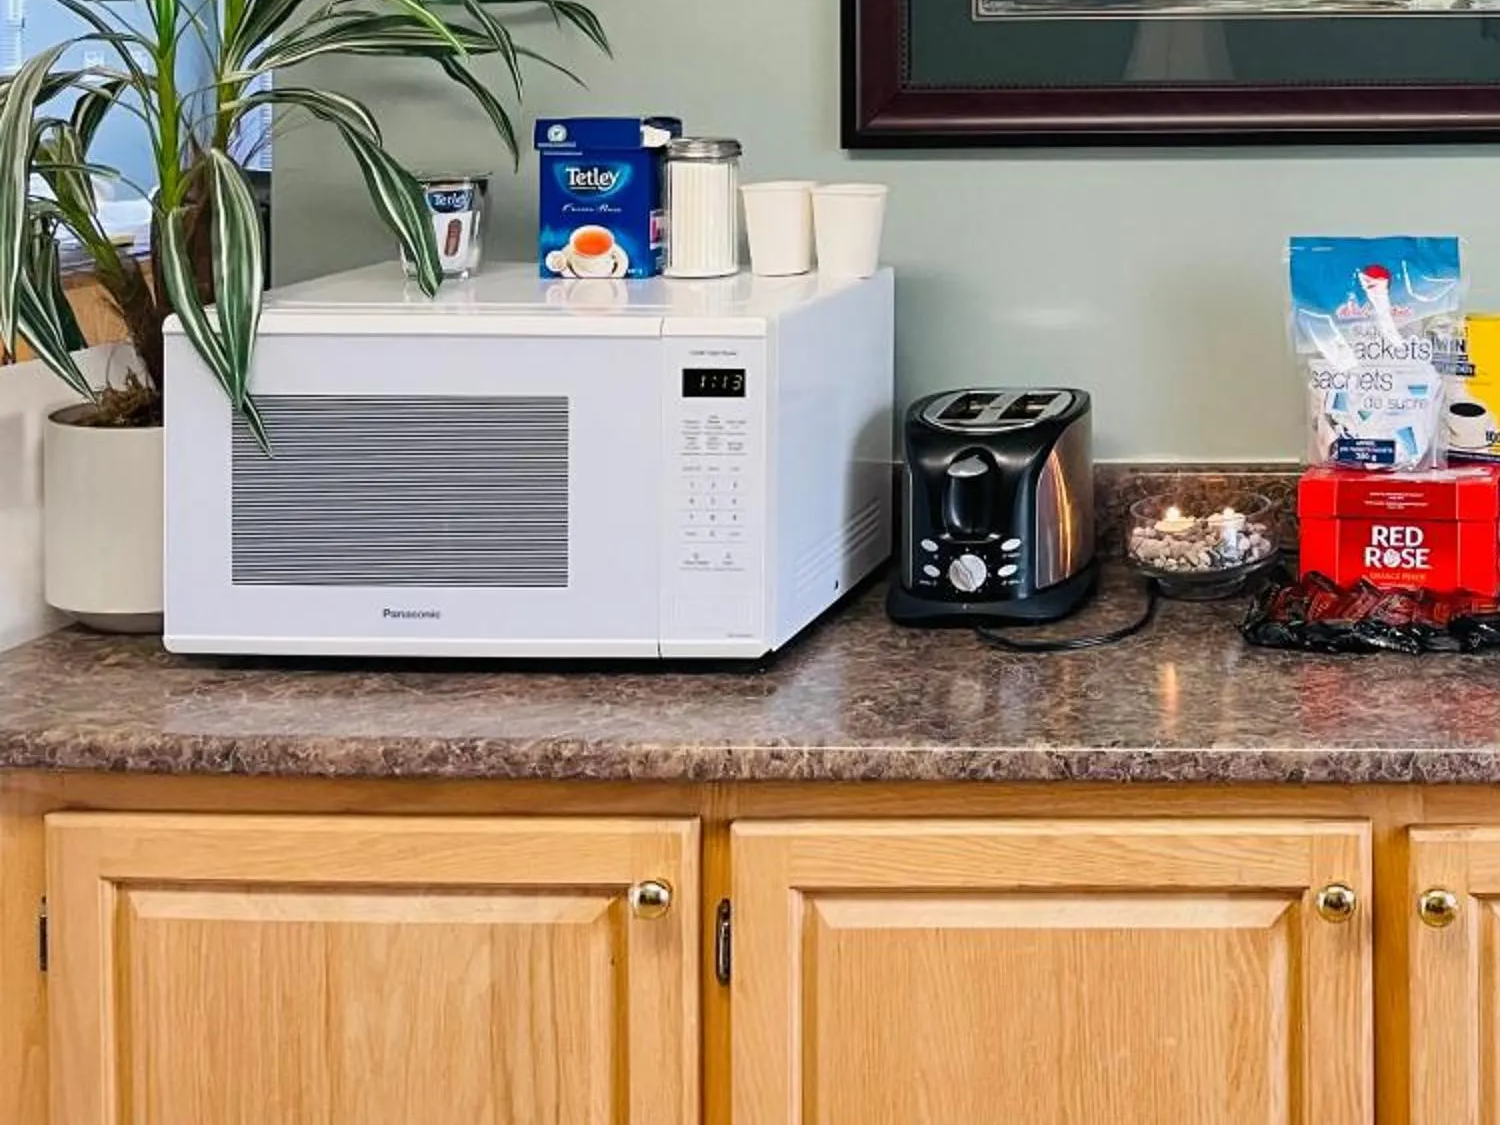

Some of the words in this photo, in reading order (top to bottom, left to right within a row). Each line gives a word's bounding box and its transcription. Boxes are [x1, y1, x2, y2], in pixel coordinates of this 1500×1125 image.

[565, 167, 620, 191] Tetley
[1350, 336, 1431, 360] ackets
[699, 374, 743, 391] 1:13
[1371, 525, 1424, 547] RED
[1364, 547, 1432, 569] ROSE
